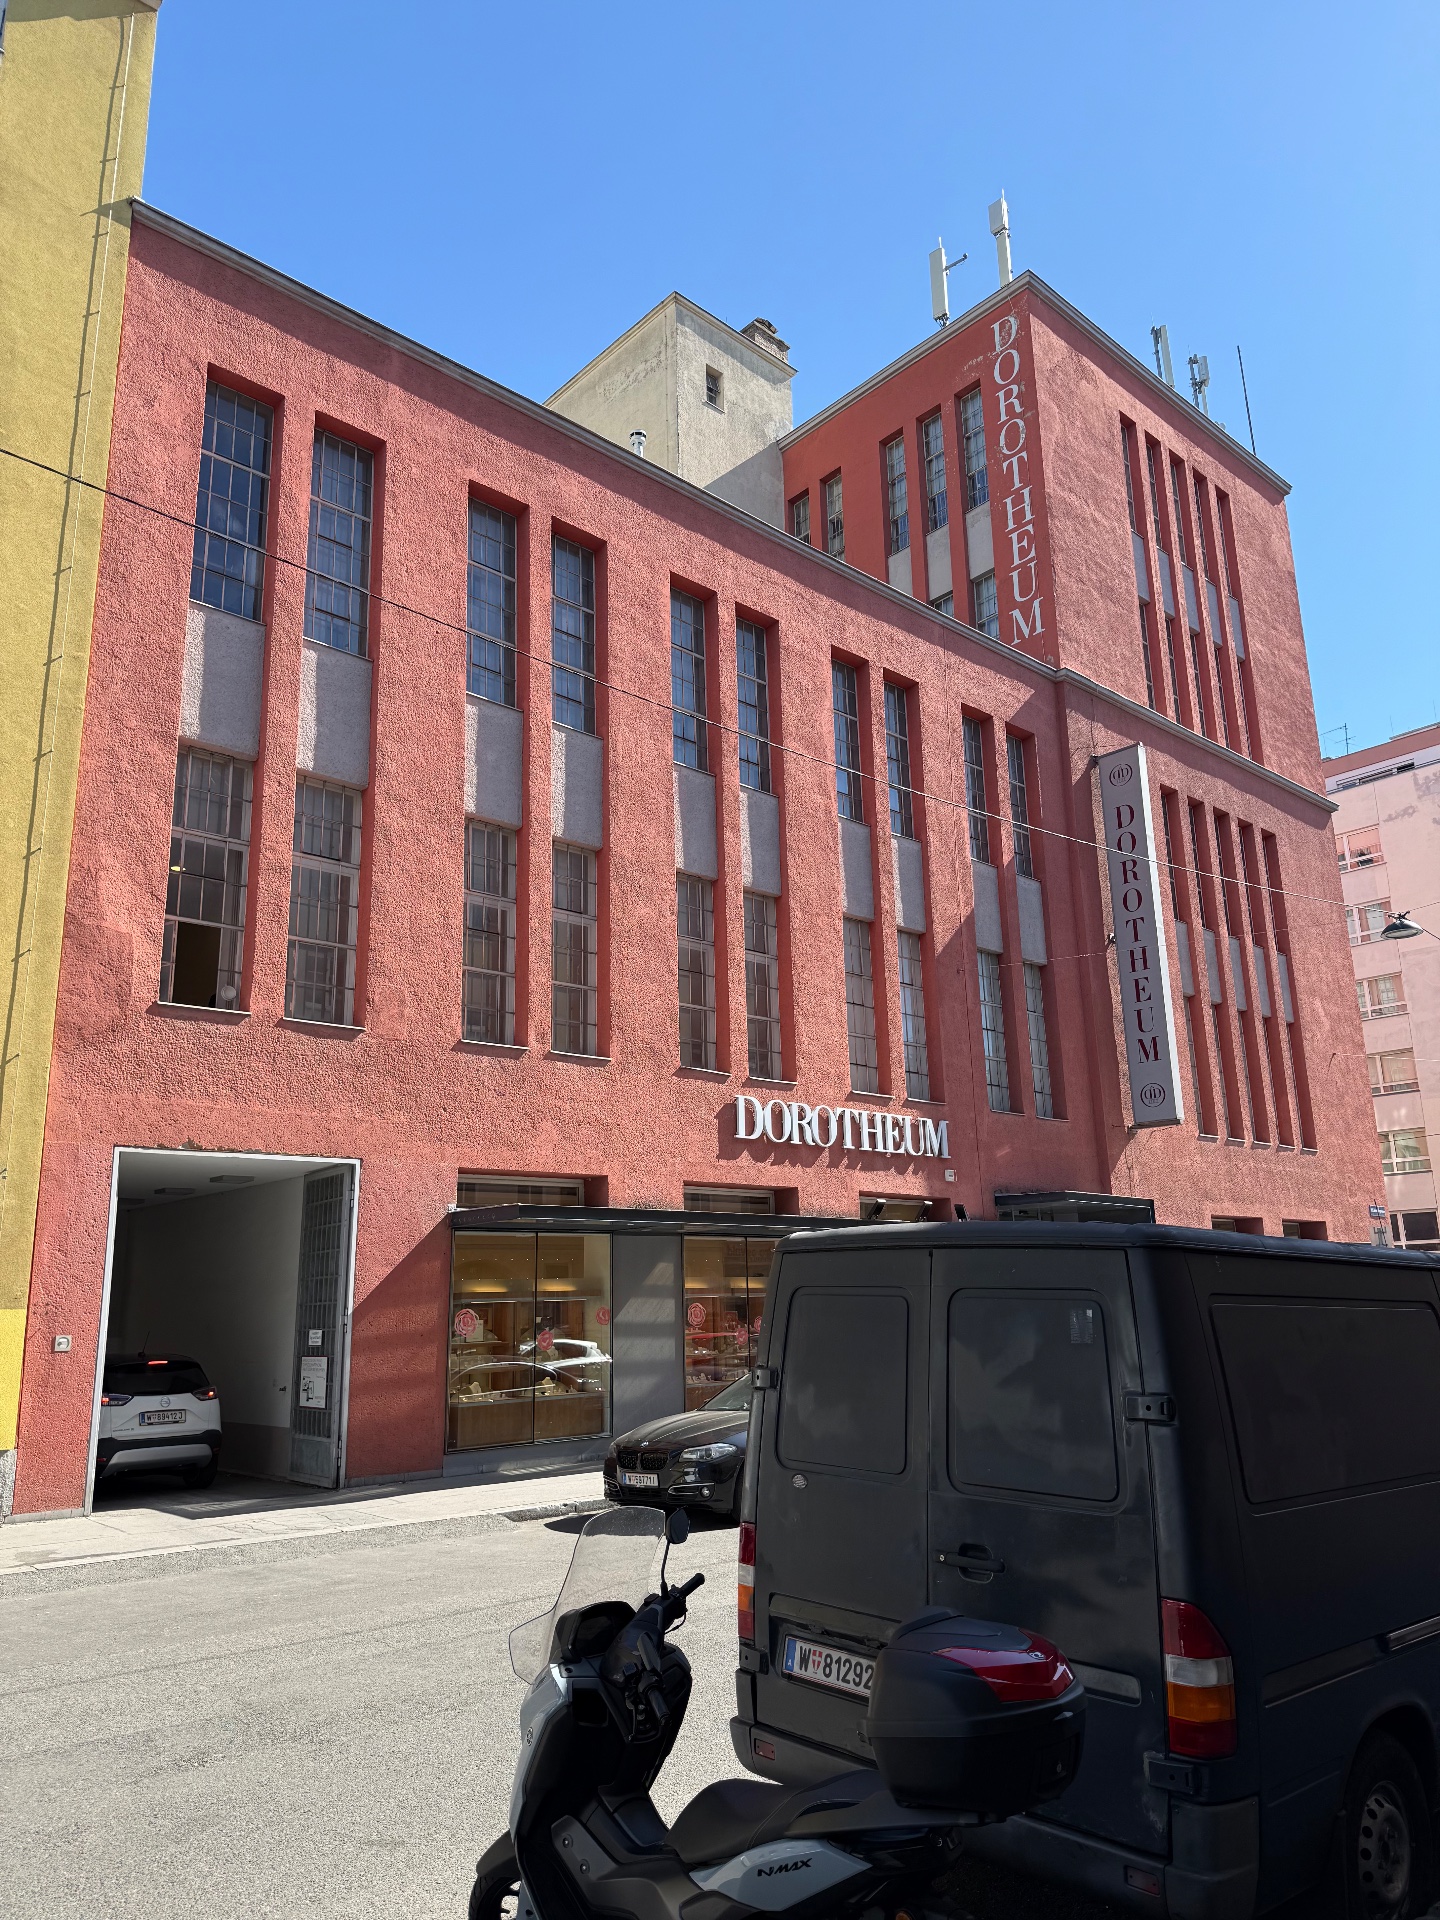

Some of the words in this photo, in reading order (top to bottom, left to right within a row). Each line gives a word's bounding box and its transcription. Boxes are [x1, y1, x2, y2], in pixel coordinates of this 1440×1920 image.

[991, 315, 1046, 646] DOROTHEUM
[1114, 803, 1162, 1065] DOROTHEUM
[734, 1094, 951, 1159] DOROTHEUM
[799, 1645, 811, 1672] W
[823, 1653, 875, 1690] 81292
[757, 1858, 813, 1877] NMAX
